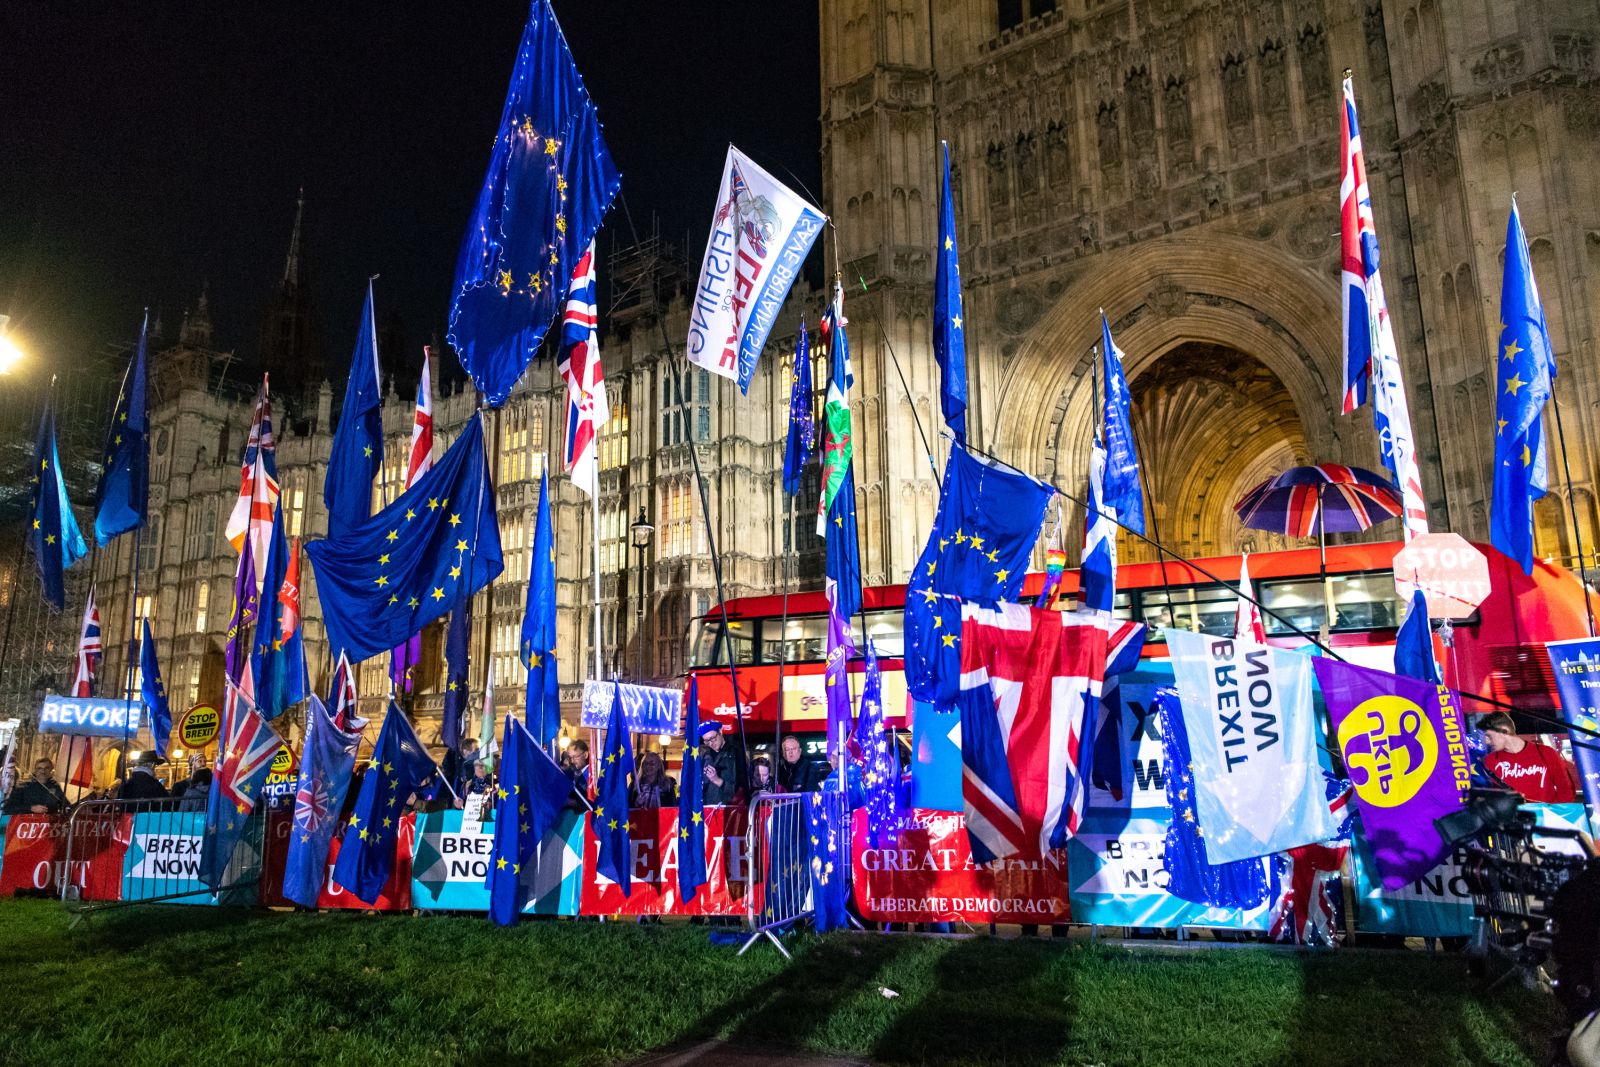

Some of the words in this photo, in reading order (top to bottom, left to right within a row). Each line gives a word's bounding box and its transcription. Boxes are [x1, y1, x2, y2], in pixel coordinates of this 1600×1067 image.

[1404, 547, 1476, 571] STOP
[1395, 580, 1487, 600] EXIT
[1562, 665, 1583, 674] THE
[43, 702, 141, 729] REVOKE
[648, 697, 674, 722] IN
[189, 713, 217, 724] STOP
[185, 727, 215, 739] BREXIT
[261, 783, 297, 796] TICLE
[17, 822, 49, 839] GET
[147, 838, 202, 855] BREX
[153, 859, 201, 875] NOW
[861, 848, 956, 871] GREAT
[33, 860, 91, 889] OUT
[871, 897, 949, 913] LIBERATE
[952, 897, 1058, 914] DEMOCRACY
